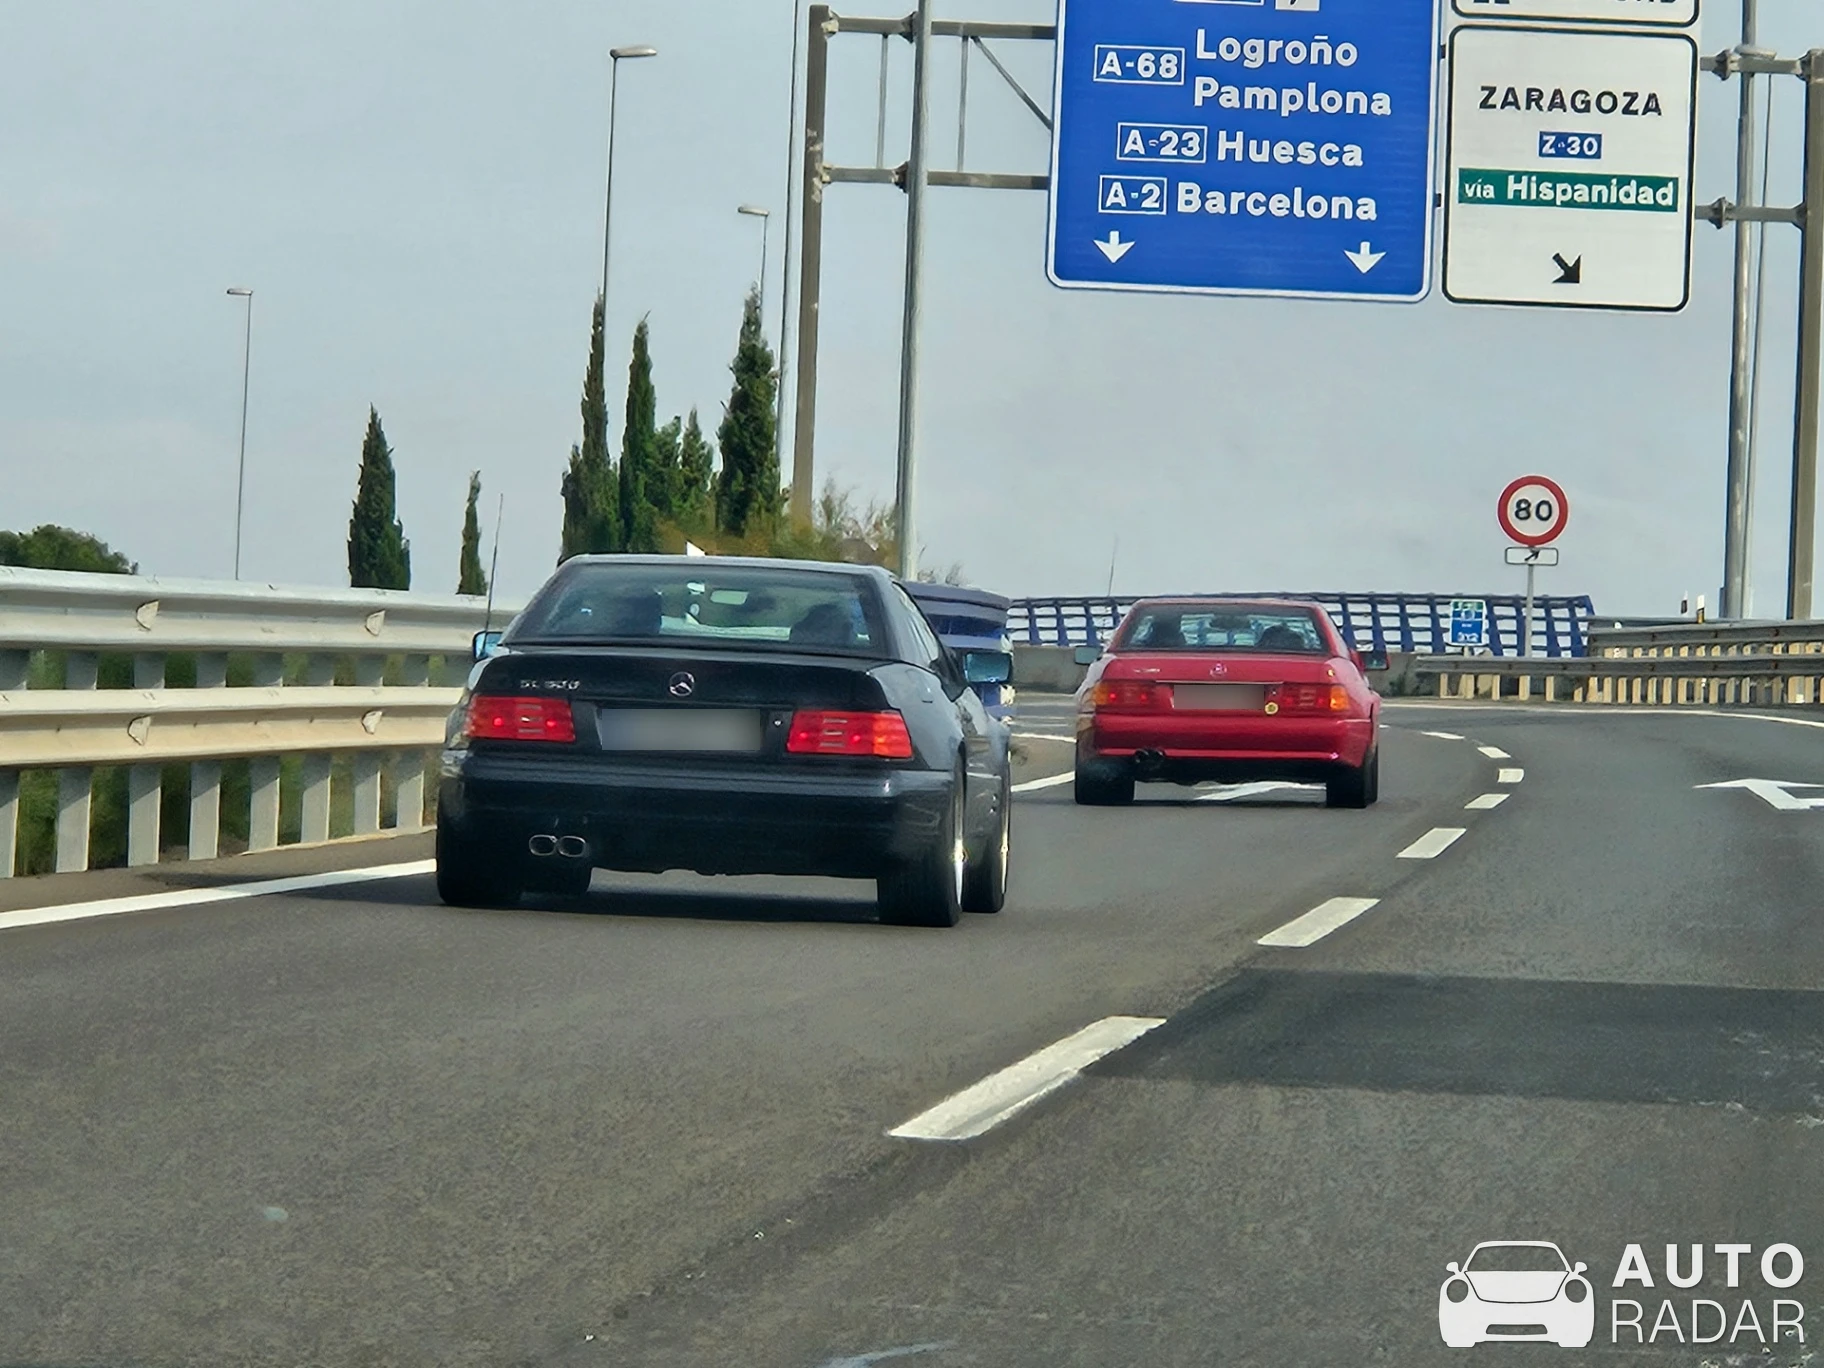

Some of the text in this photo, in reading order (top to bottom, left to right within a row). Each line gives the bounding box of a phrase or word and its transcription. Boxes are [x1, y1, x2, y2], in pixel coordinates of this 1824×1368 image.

[1196, 28, 1358, 68] Logroño
[1100, 51, 1179, 79] A-68
[1194, 77, 1392, 117] Pamplona
[1479, 85, 1662, 117] ZARAGOZA
[1123, 129, 1363, 166] A-23 Huesca
[1542, 135, 1598, 156] Z-30
[1105, 181, 1377, 221] A-2 Barcelona
[1464, 175, 1674, 206] vía Hispanidad
[1514, 498, 1553, 521] 80
